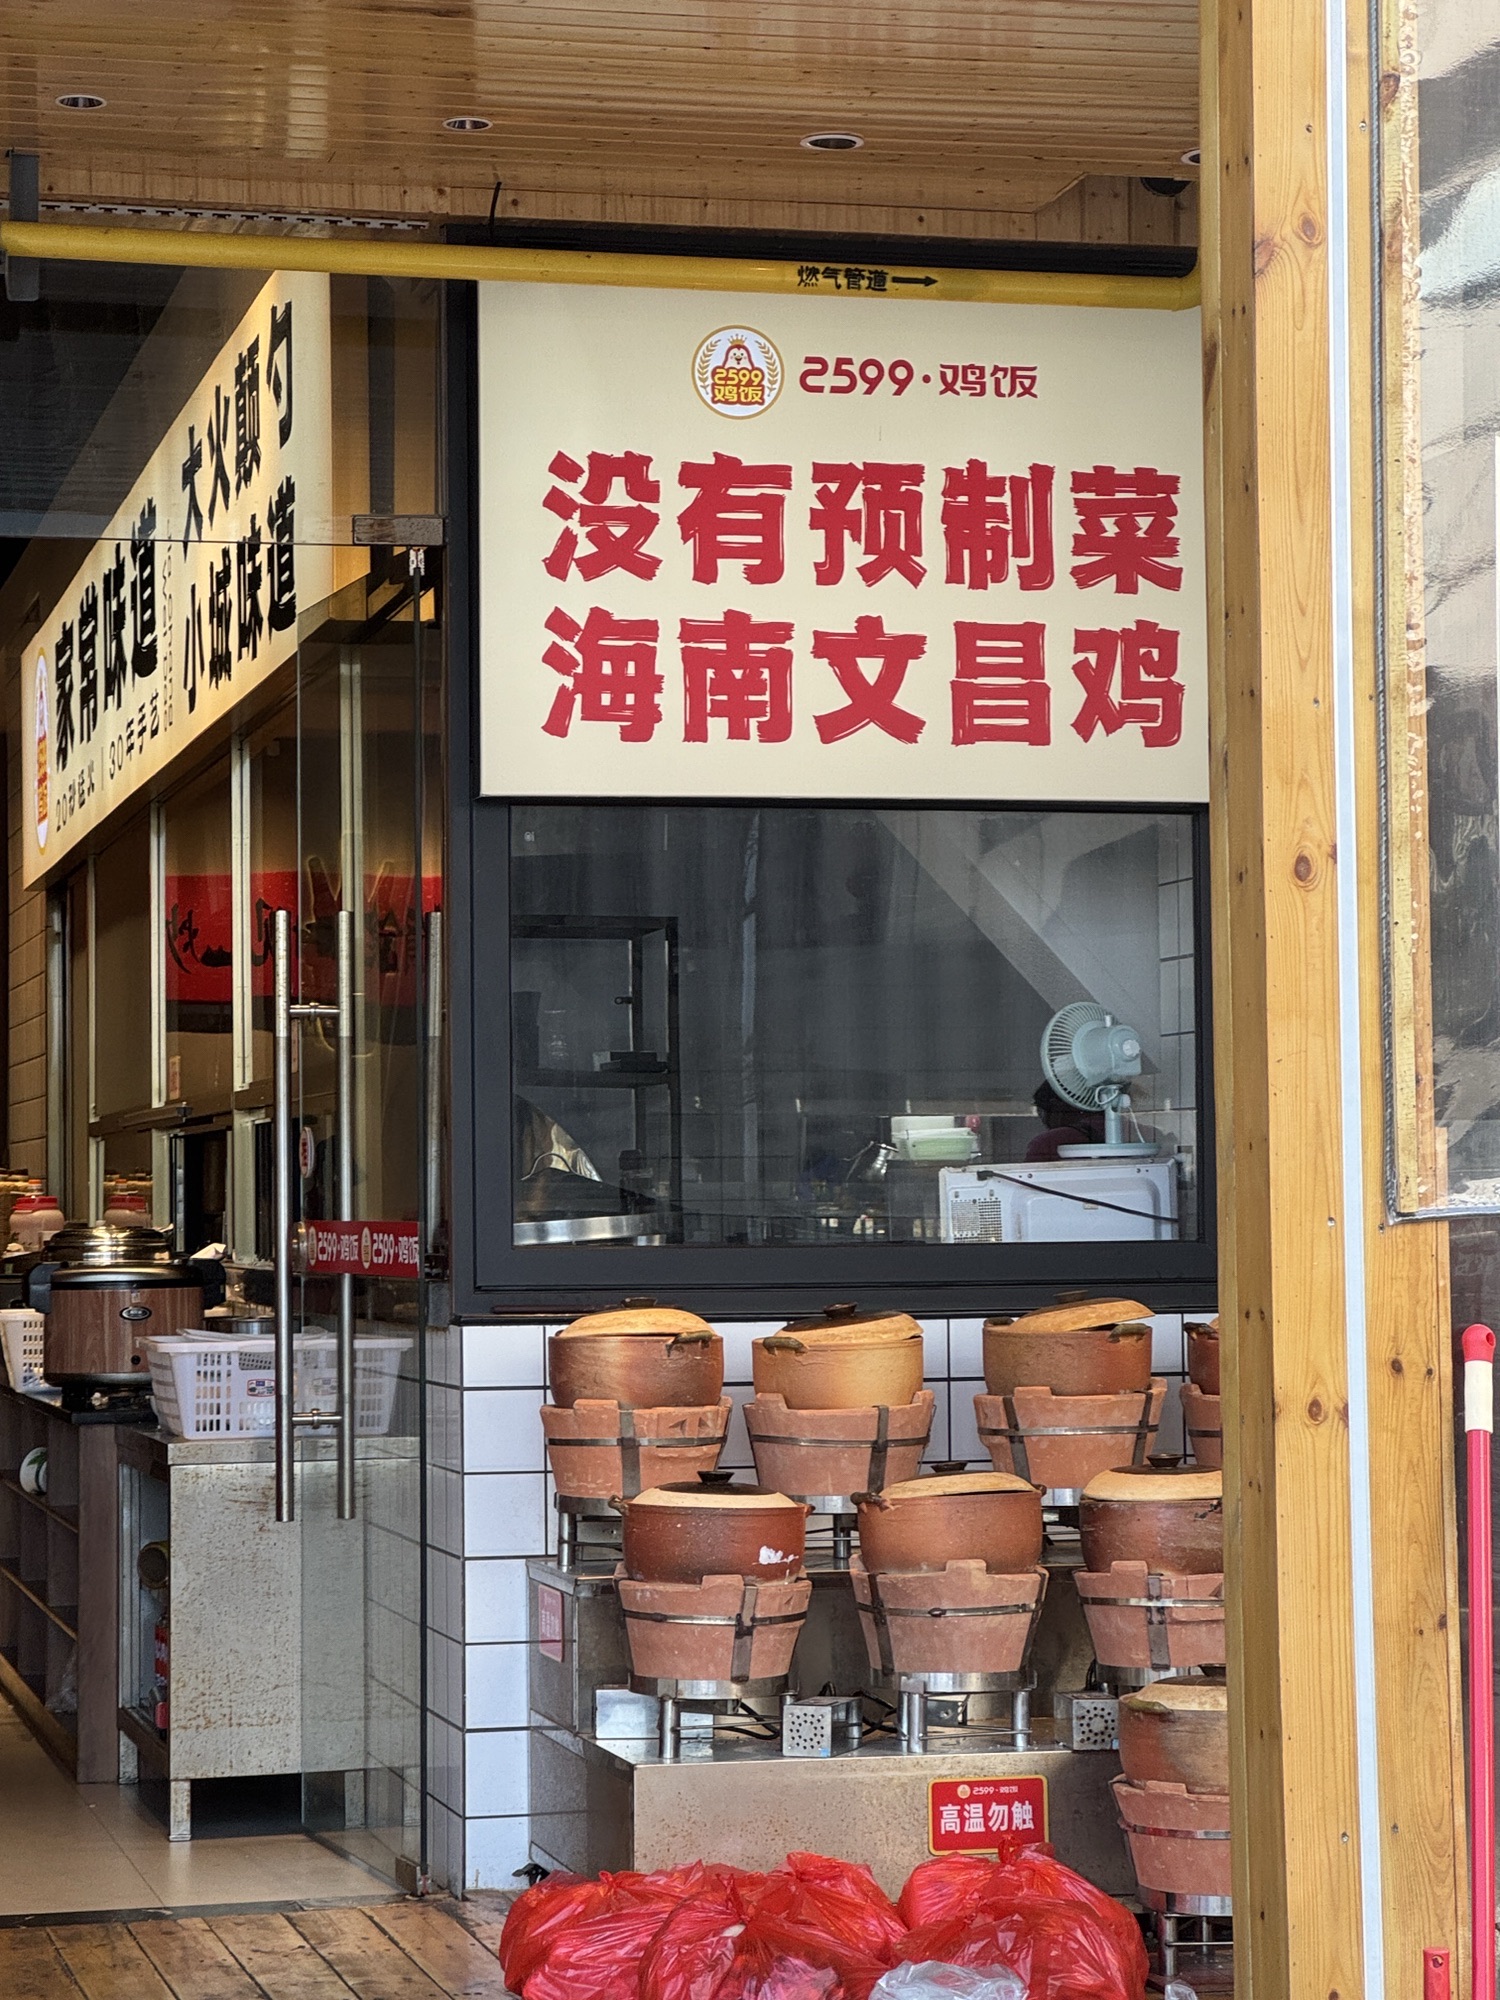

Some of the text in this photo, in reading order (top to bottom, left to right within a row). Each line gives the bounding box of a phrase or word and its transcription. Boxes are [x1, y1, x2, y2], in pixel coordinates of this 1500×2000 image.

[797, 265, 888, 291] 燃气管道
[714, 368, 761, 384] 2599
[714, 385, 763, 403] 鸡饭
[799, 356, 1038, 399] 2599·鸡饭
[181, 300, 293, 562] 大火颠勺
[541, 450, 1184, 594] 没有预制菜
[55, 497, 158, 773] 家常味道
[184, 474, 296, 714] 小城味道
[541, 606, 1186, 749] 海南文昌鸡
[109, 688, 159, 781] 30年手艺
[939, 1800, 1035, 1835] 高温勿触
